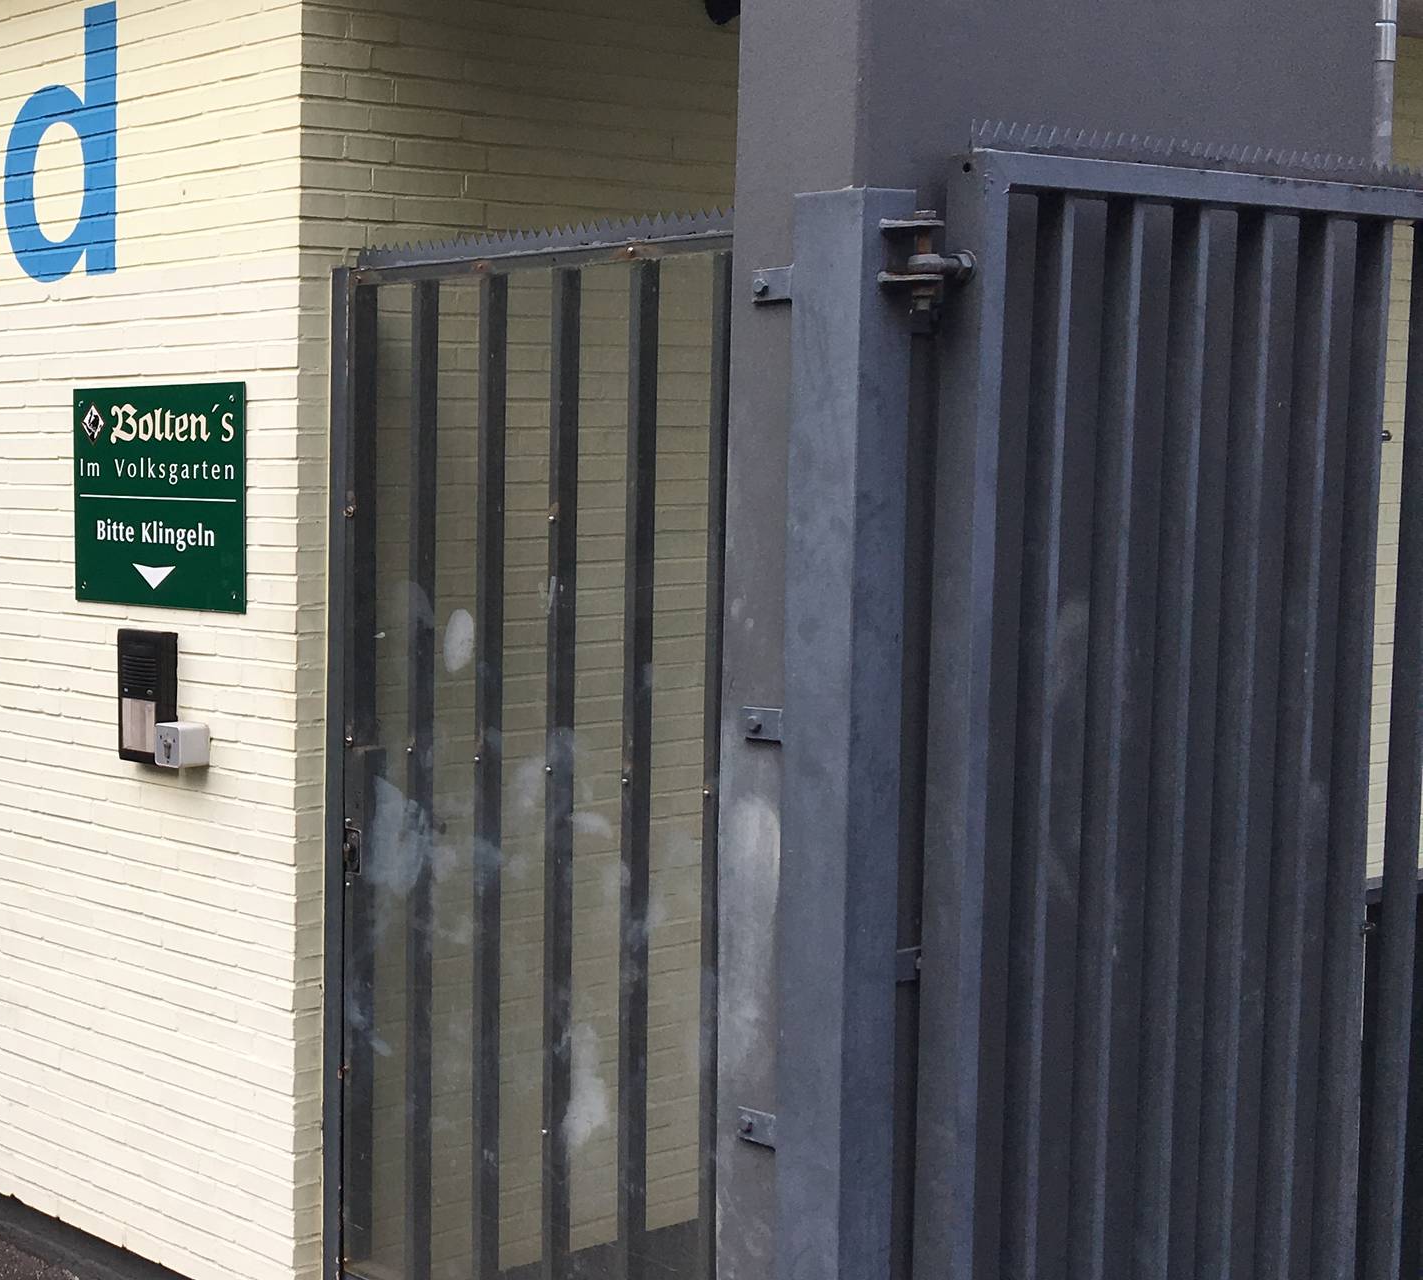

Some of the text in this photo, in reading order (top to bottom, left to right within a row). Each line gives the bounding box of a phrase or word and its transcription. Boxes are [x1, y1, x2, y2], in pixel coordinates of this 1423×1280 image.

[80, 457, 235, 484] Im Volksgarten
[96, 518, 215, 552] Bitte Klingeln
